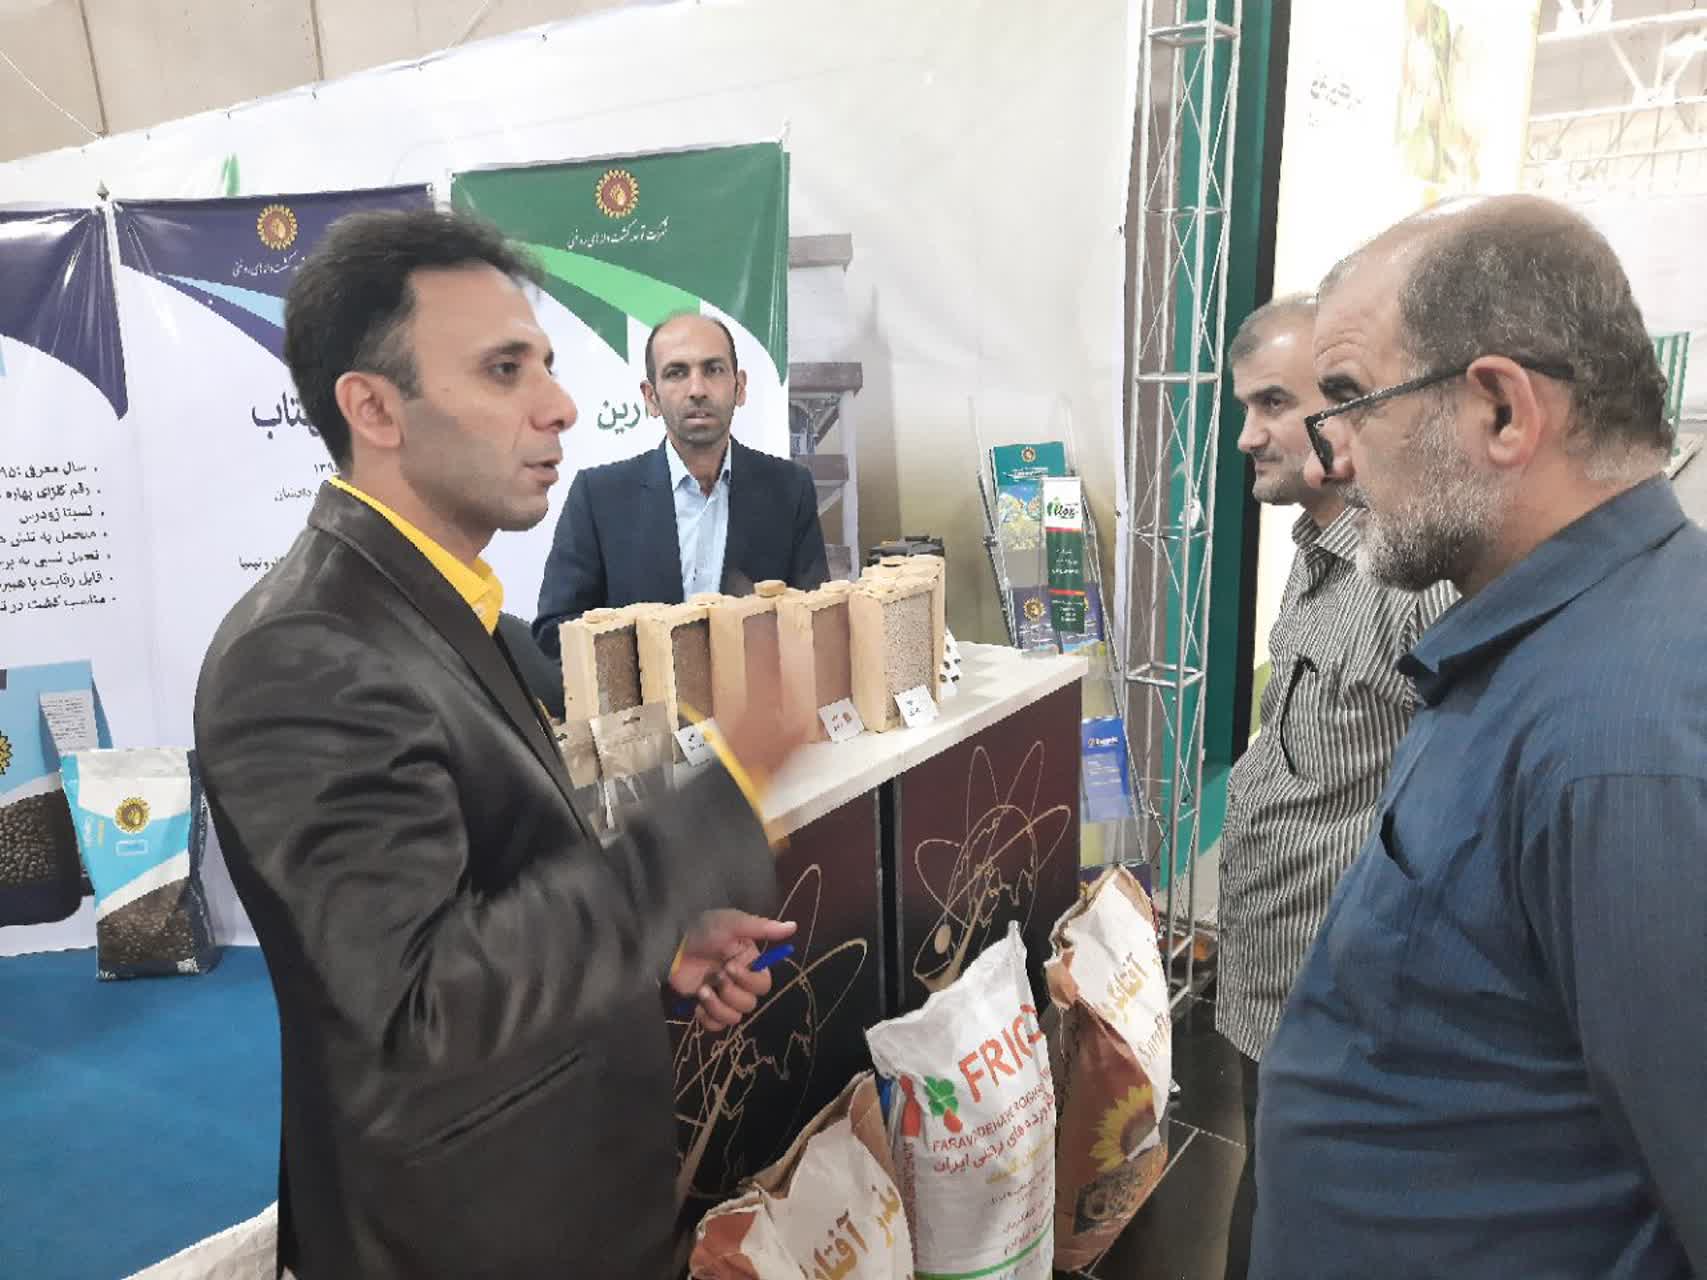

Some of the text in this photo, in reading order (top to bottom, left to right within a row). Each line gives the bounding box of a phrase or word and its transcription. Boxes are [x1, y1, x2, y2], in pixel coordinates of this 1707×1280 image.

[24, 463, 58, 479] معرفی
[62, 460, 87, 476] سال
[6, 482, 90, 501] رقم کلزای بهاره
[19, 504, 93, 525] نسبتا زودرس
[40, 530, 52, 545] به
[55, 529, 97, 544] متحمل
[18, 555, 30, 567] به
[34, 550, 63, 569] نسبی
[27, 576, 38, 592] با
[40, 572, 75, 588] رقابت
[78, 569, 103, 587] قابل
[9, 599, 23, 614] در
[27, 593, 61, 609] کشت
[63, 594, 106, 611] مناسب
